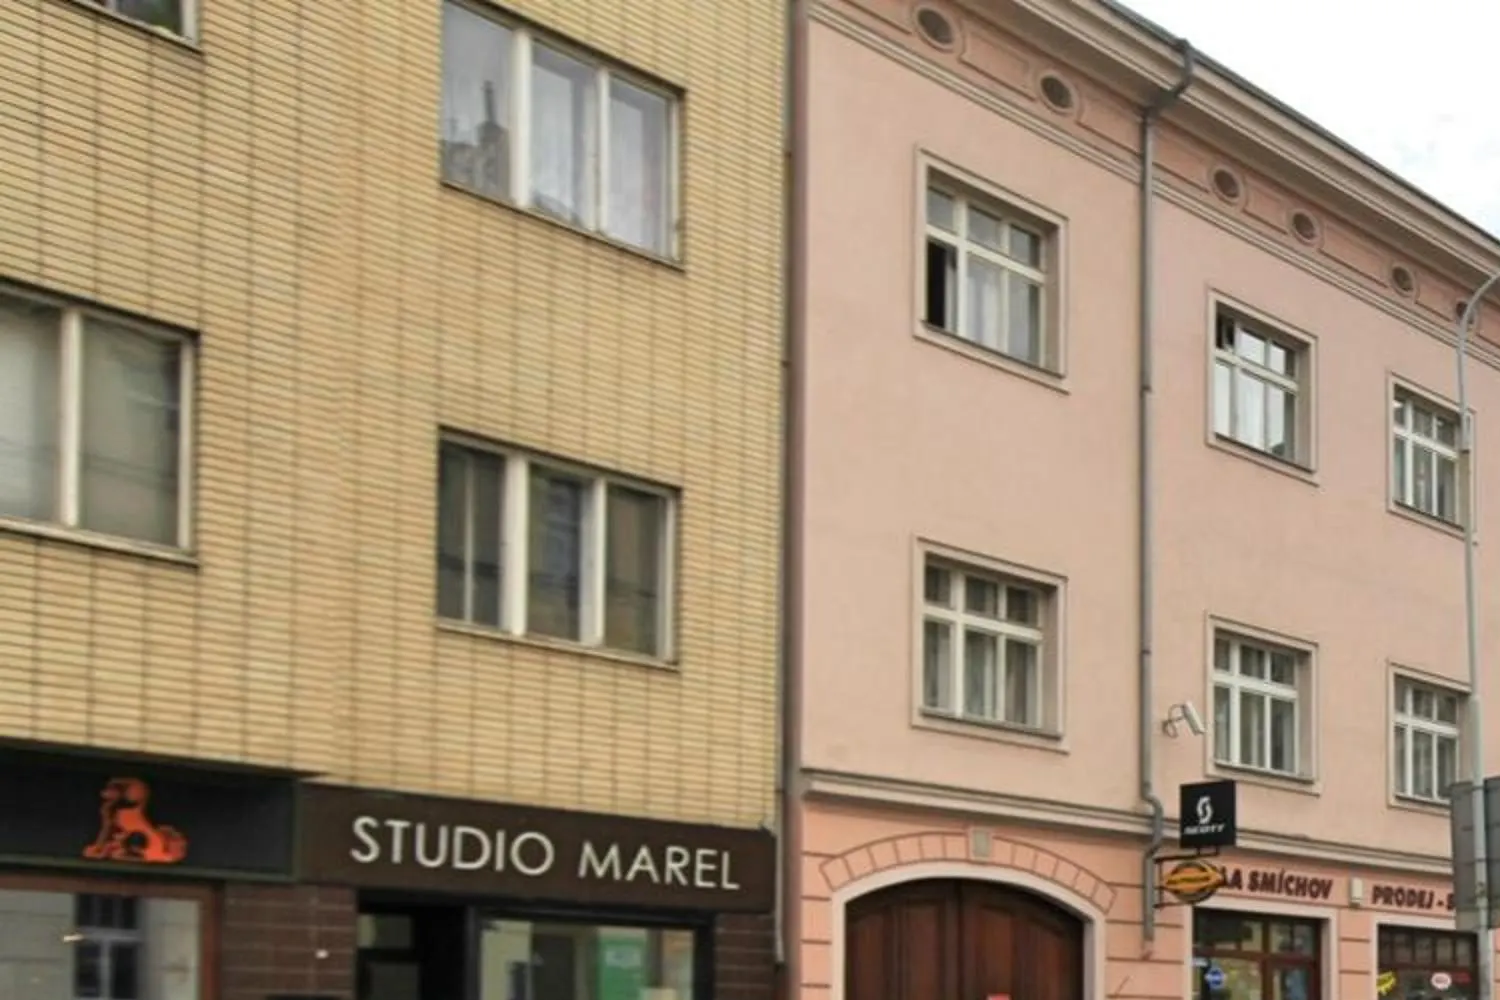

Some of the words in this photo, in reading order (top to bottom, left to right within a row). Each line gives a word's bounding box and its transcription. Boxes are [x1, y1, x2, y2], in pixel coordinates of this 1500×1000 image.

[350, 815, 555, 876] STUDIO
[577, 841, 741, 890] MAREL
[1247, 868, 1334, 900] SMÍCHOV
[1371, 884, 1435, 910] PRODEJ
